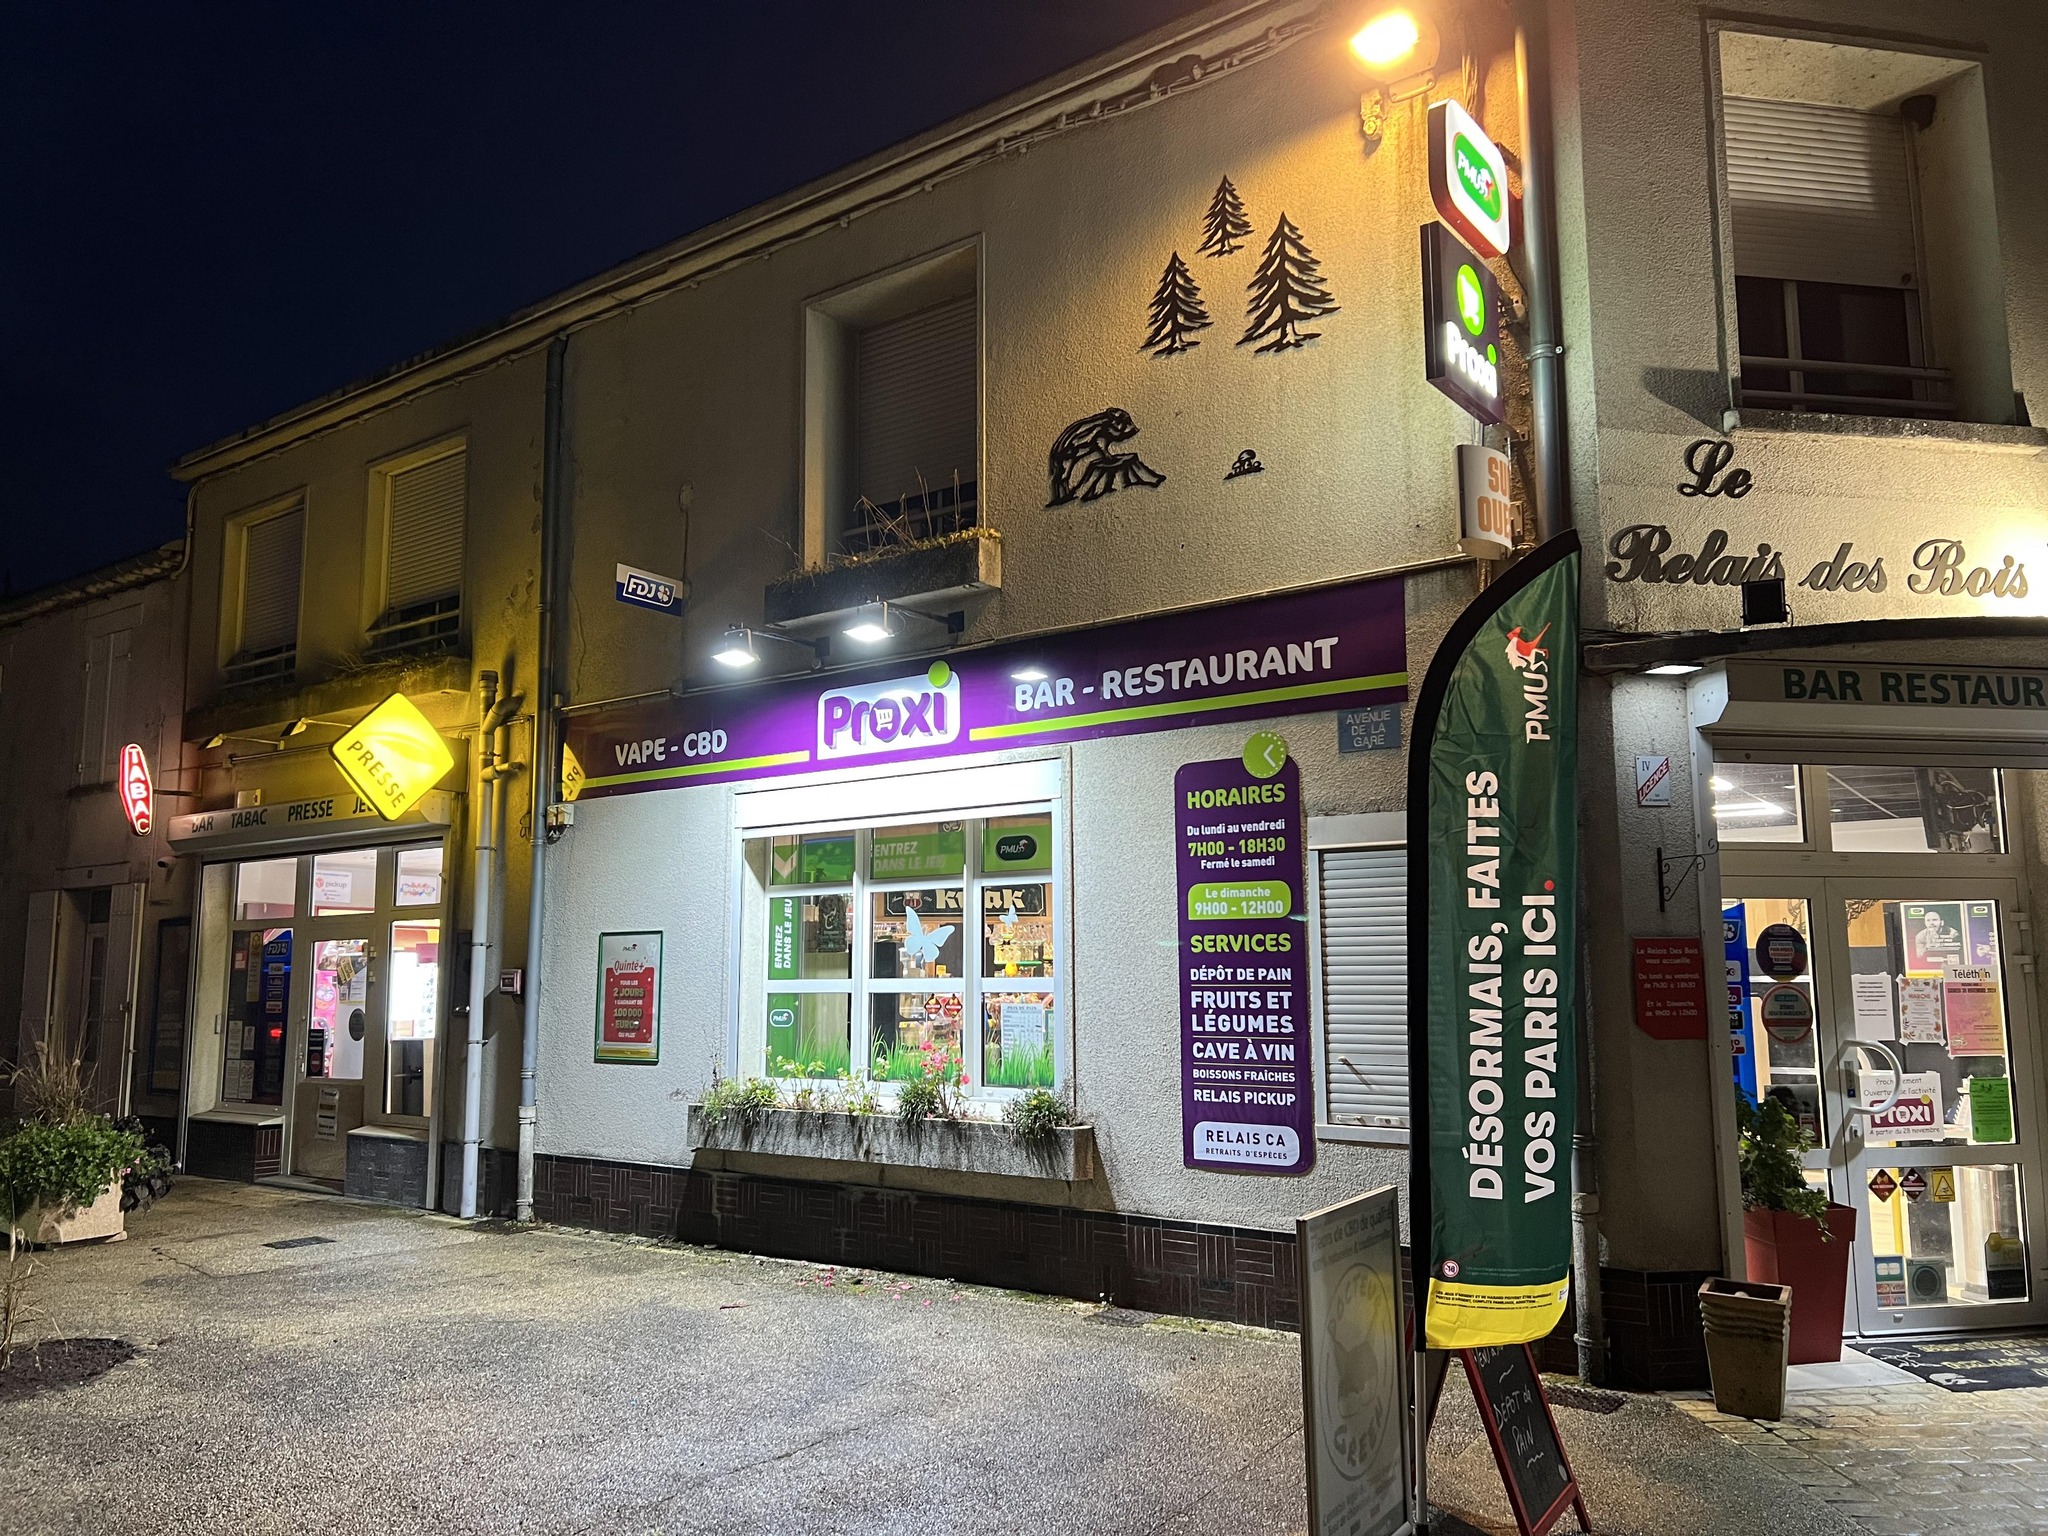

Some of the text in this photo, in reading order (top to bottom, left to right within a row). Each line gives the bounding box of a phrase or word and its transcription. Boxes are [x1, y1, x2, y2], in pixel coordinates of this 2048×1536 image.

[1457, 149, 1484, 190] PMU
[1677, 439, 1753, 499] Le
[1605, 524, 2029, 599] Relais des Bois
[628, 577, 657, 598] FDJ
[1014, 677, 1076, 713] BAR
[1102, 636, 1339, 701] RESTAURANT
[1783, 667, 2047, 707] BAR RESTAUR
[823, 660, 952, 751] Proxi
[1522, 670, 1551, 745] PMU
[1346, 710, 1391, 725] AVENUE
[1352, 722, 1386, 736] DE LA
[615, 737, 666, 767] VAPE
[683, 729, 728, 758] CBD
[1353, 735, 1385, 747] GARE
[347, 740, 406, 808] PRESSE
[1641, 760, 1651, 771] IV
[1638, 759, 1669, 800] LICENCE
[128, 749, 150, 833] TABAC
[1187, 783, 1286, 810] HORAIRES
[231, 808, 268, 829] TABAC
[288, 799, 334, 823] PRESSE
[1187, 818, 1286, 837] Du lundi au vendredi
[874, 840, 918, 857] ENTREZ
[1000, 844, 1019, 855] PMU
[1188, 841, 1225, 857] 7H00
[1239, 836, 1286, 854] 18H30
[874, 858, 905, 872] DANS
[908, 856, 922, 870] LE
[1200, 855, 1275, 870] Fermé le samedi
[325, 881, 347, 889] pickup
[1205, 886, 1271, 899] Le dimanche
[1194, 901, 1228, 916] 9H00
[1240, 900, 1284, 915] 12H00
[783, 898, 793, 969] DANS LE JEU
[1190, 933, 1292, 953] SERVICES
[267, 943, 281, 954] FDJ
[774, 925, 783, 969] ENTREZ
[614, 960, 645, 972] Quinté+
[1190, 964, 1292, 981] DÉPÔT DE PAIN
[613, 988, 645, 998] 2 JOURS
[1461, 769, 1509, 1200] DÉSORMAIS, FAITES
[1191, 990, 1293, 1010] FRUITS ET
[1191, 1010, 1295, 1033] LÉGUMES
[1192, 1038, 1295, 1061] CAVE À VIN
[1521, 880, 1559, 1204] VOS PARIS ICI.
[1192, 1068, 1296, 1083] BOISSONS FRAÎCHES
[1193, 1088, 1296, 1106] RELAIS PICKUP
[1206, 1129, 1286, 1147] RELAIS CA
[1205, 1147, 1241, 1157] RETRAITS
